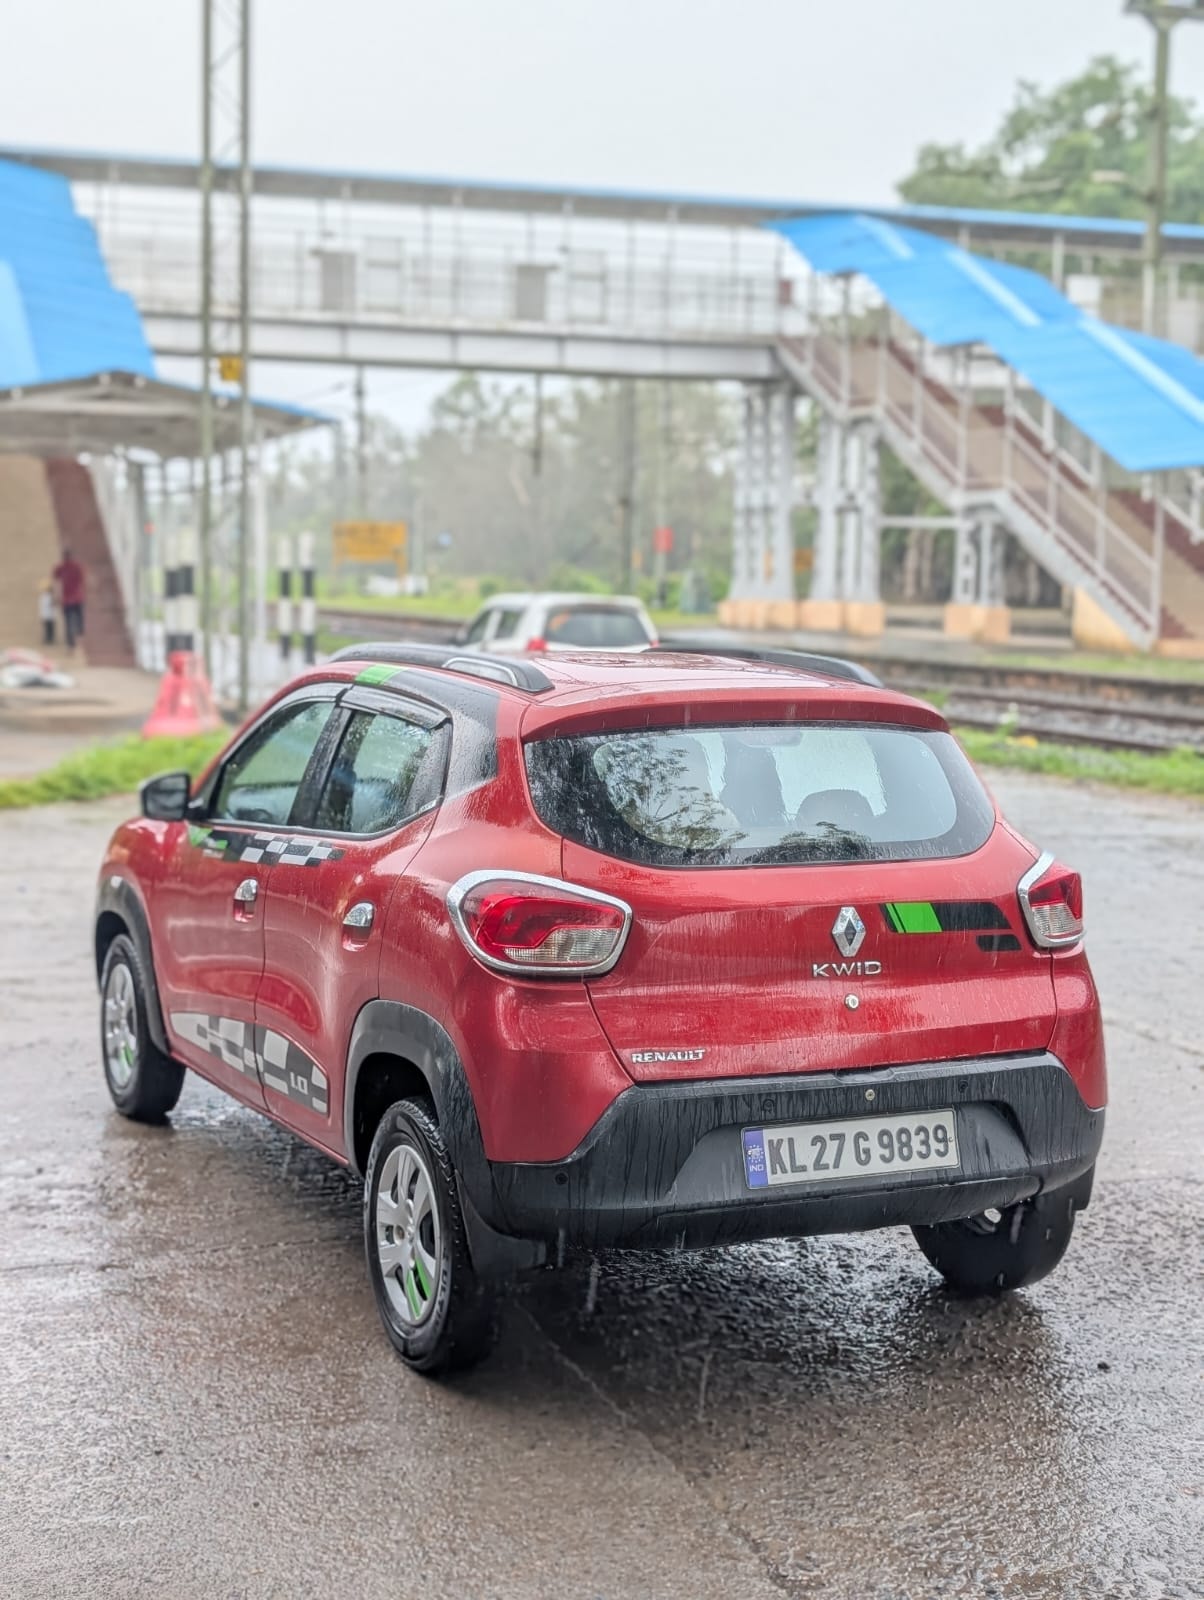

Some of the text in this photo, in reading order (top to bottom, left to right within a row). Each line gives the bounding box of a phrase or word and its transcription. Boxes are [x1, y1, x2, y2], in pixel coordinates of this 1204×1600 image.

[812, 961, 882, 977] KWID
[631, 1049, 706, 1063] RENAULT
[877, 1124, 950, 1163] 9839
